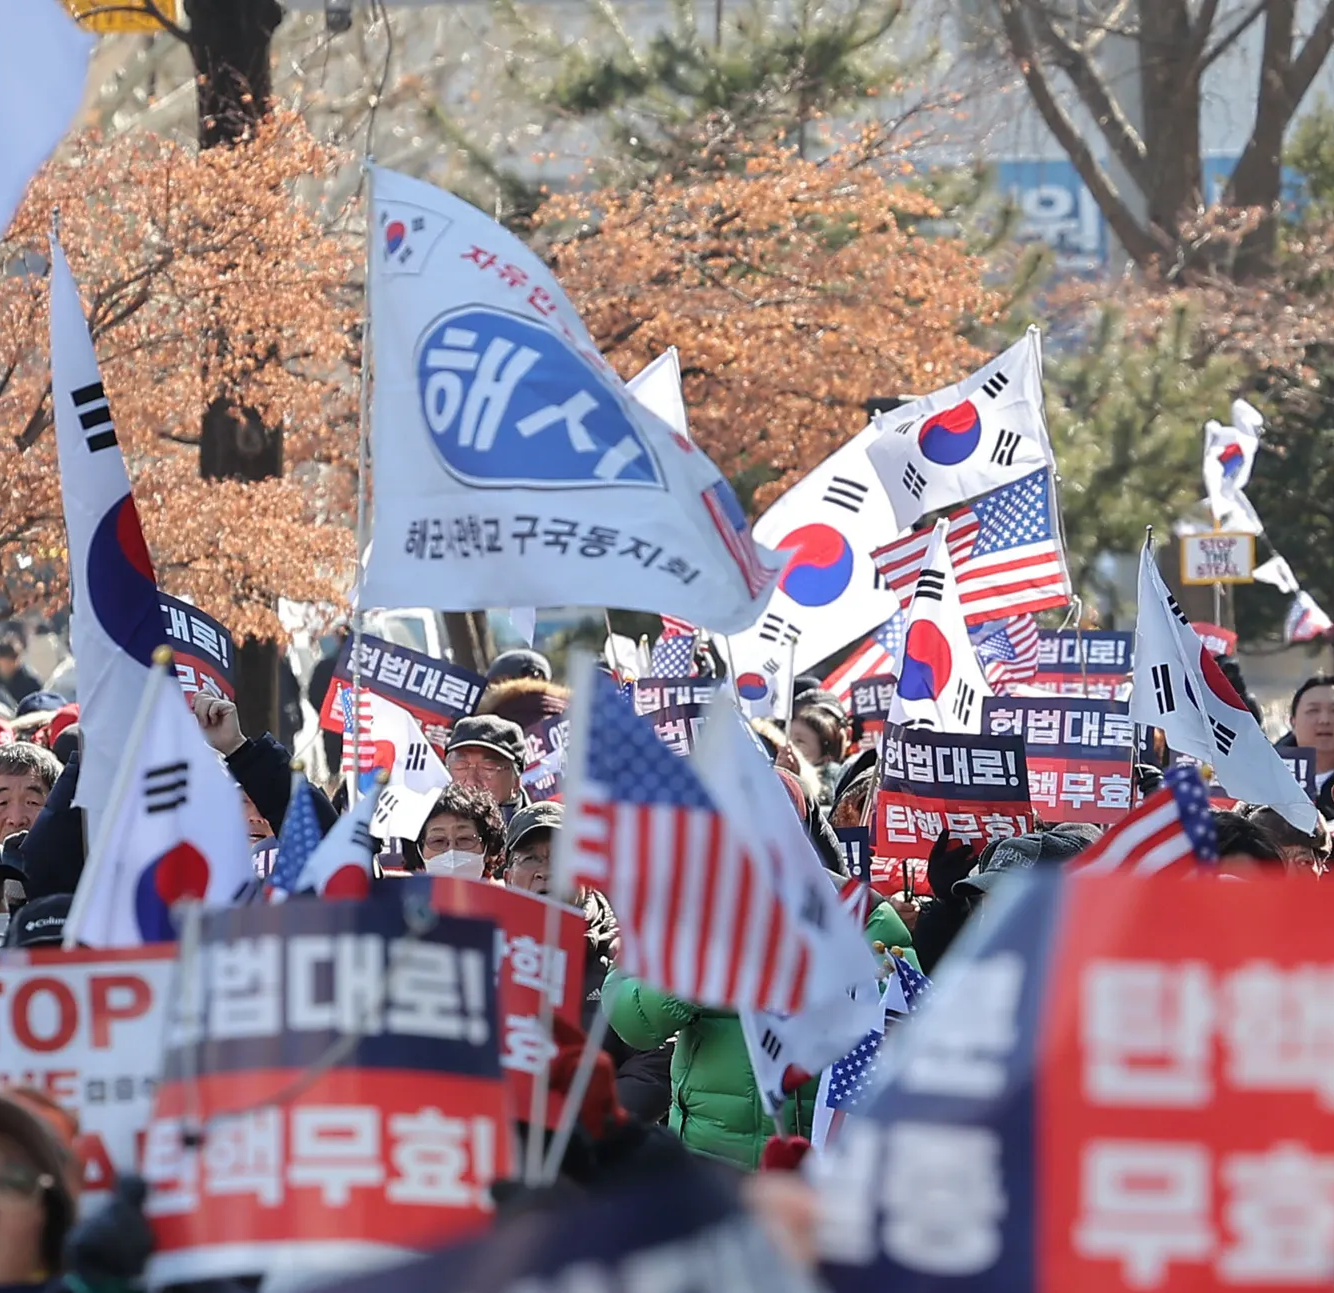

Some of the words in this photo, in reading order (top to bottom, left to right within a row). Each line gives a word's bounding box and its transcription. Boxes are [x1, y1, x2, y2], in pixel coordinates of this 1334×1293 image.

[511, 514, 703, 586] 구국동지회
[1199, 538, 1237, 551] STOP
[1205, 552, 1230, 564] THE
[1196, 563, 1242, 577] STEAL
[346, 641, 481, 714] 헌법대로!
[989, 708, 1148, 751] 헌법대로!
[883, 735, 1020, 787] 헌법대로!
[885, 804, 1028, 846] 탄핵무효!
[144, 1105, 496, 1216] 탄핵무효!
